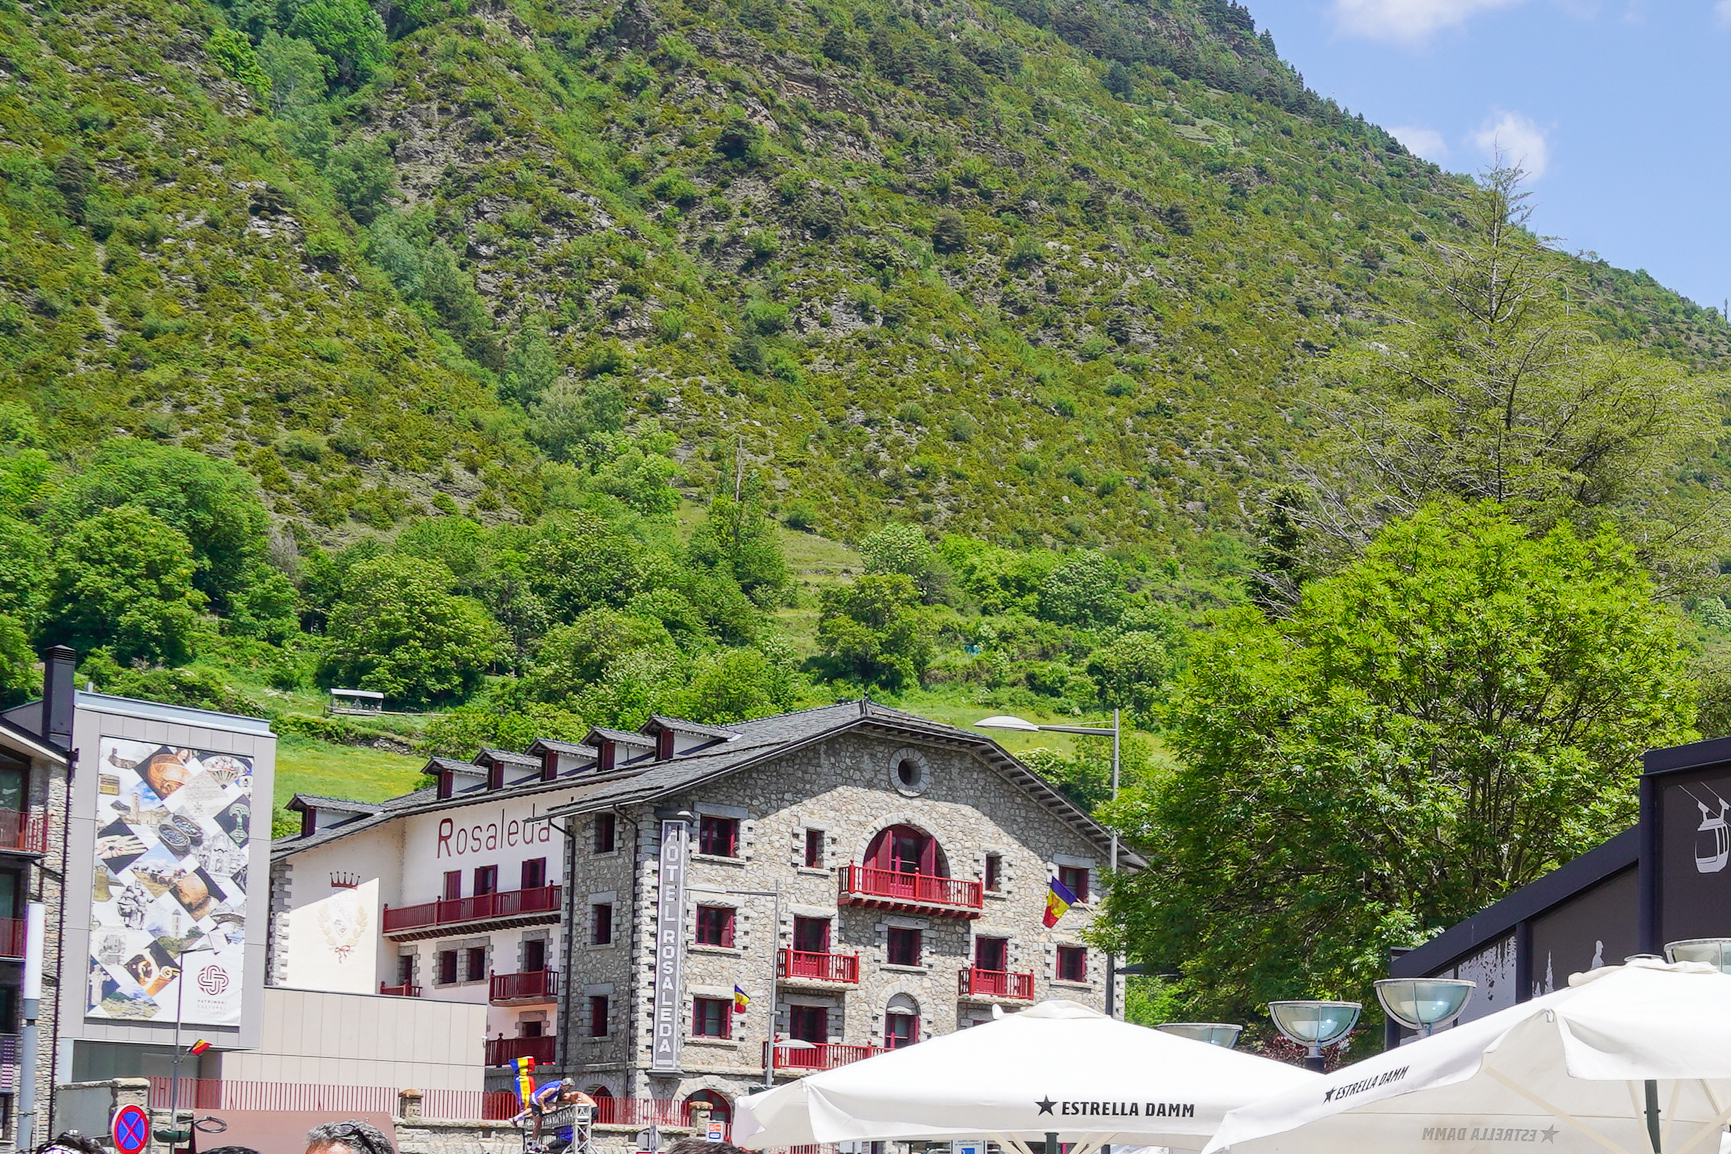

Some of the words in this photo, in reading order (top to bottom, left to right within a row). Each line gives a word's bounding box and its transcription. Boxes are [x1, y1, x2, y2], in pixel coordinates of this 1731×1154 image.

[437, 803, 551, 858] Rosaleda
[665, 825, 680, 921] HOTEL
[659, 930, 675, 1053] ROSALEDA
[1061, 1101, 1139, 1117] ESTRELLA
[1144, 1103, 1195, 1118] DAMM
[1335, 1075, 1378, 1101] ESTRELLA
[1378, 1065, 1410, 1087] DAMM
